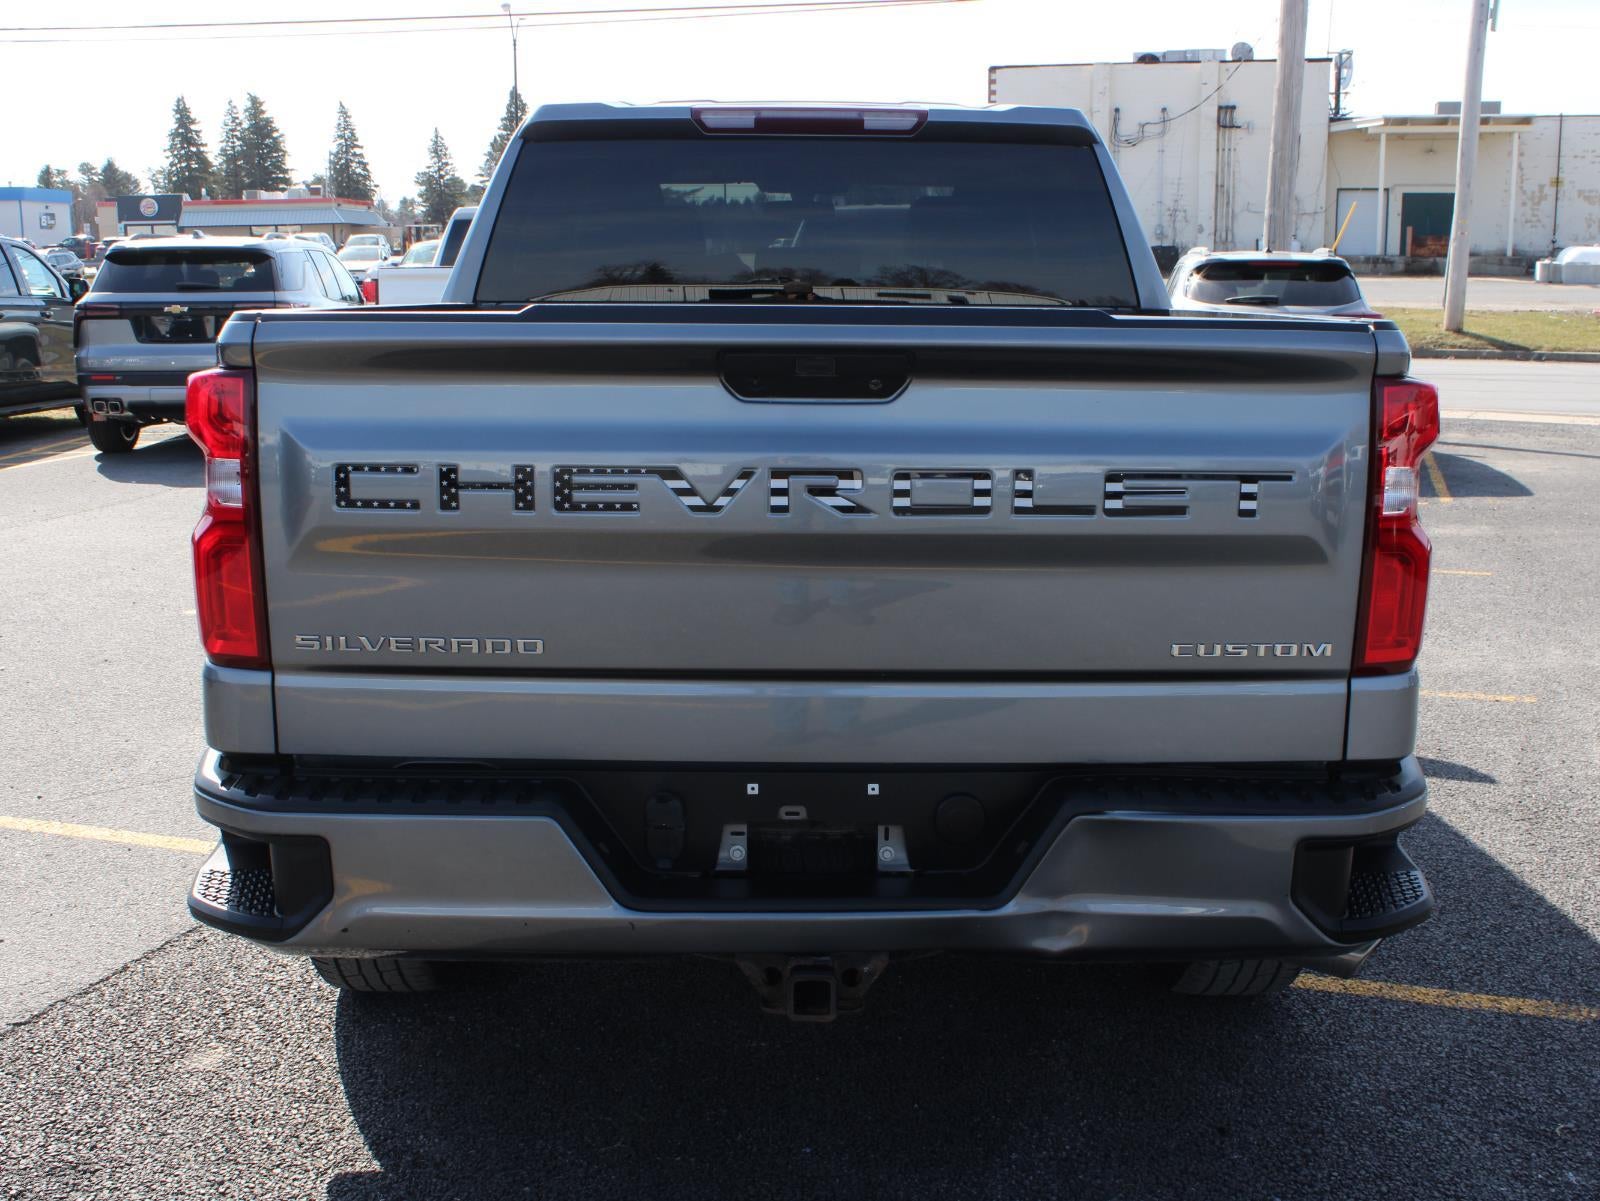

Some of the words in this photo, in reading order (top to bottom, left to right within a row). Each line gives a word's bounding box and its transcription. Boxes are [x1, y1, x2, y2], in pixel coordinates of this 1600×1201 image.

[334, 463, 1294, 517] CHEVROLET
[295, 635, 545, 655] SILVERADO
[1171, 643, 1333, 657] CUSTOM
